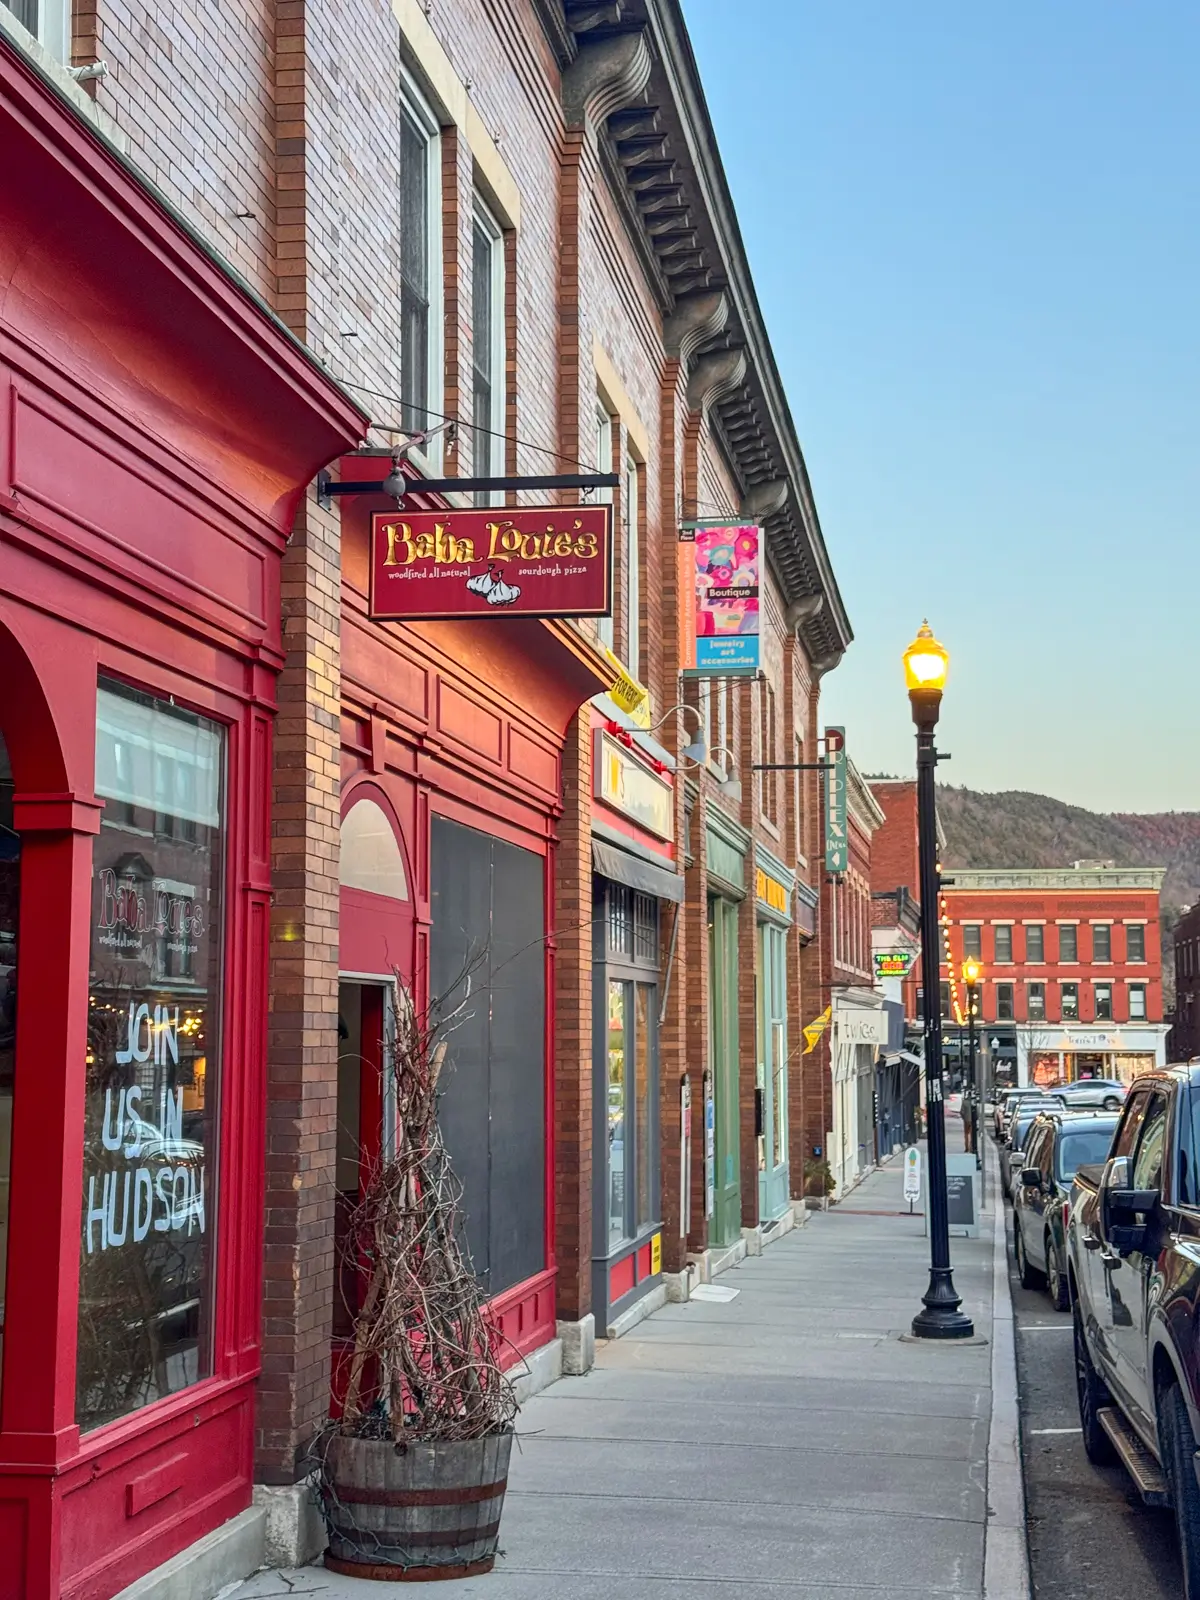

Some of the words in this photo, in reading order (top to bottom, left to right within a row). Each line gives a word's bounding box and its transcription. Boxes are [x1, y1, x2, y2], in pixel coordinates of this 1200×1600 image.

[381, 521, 483, 566] Baba
[485, 518, 599, 562] Louie's
[388, 567, 427, 580] woodfired
[429, 566, 440, 578] all
[441, 565, 471, 578] natural
[518, 564, 562, 577] sourdough
[564, 565, 587, 576] pizza
[709, 587, 751, 598] Boutique
[720, 648, 736, 656] art
[614, 677, 629, 697] FOR
[826, 735, 845, 837] TRIPLEX
[116, 1002, 179, 1065] JOIN
[102, 1085, 142, 1159] US
[161, 1086, 184, 1154] IN
[87, 1166, 205, 1254] HUDSON
